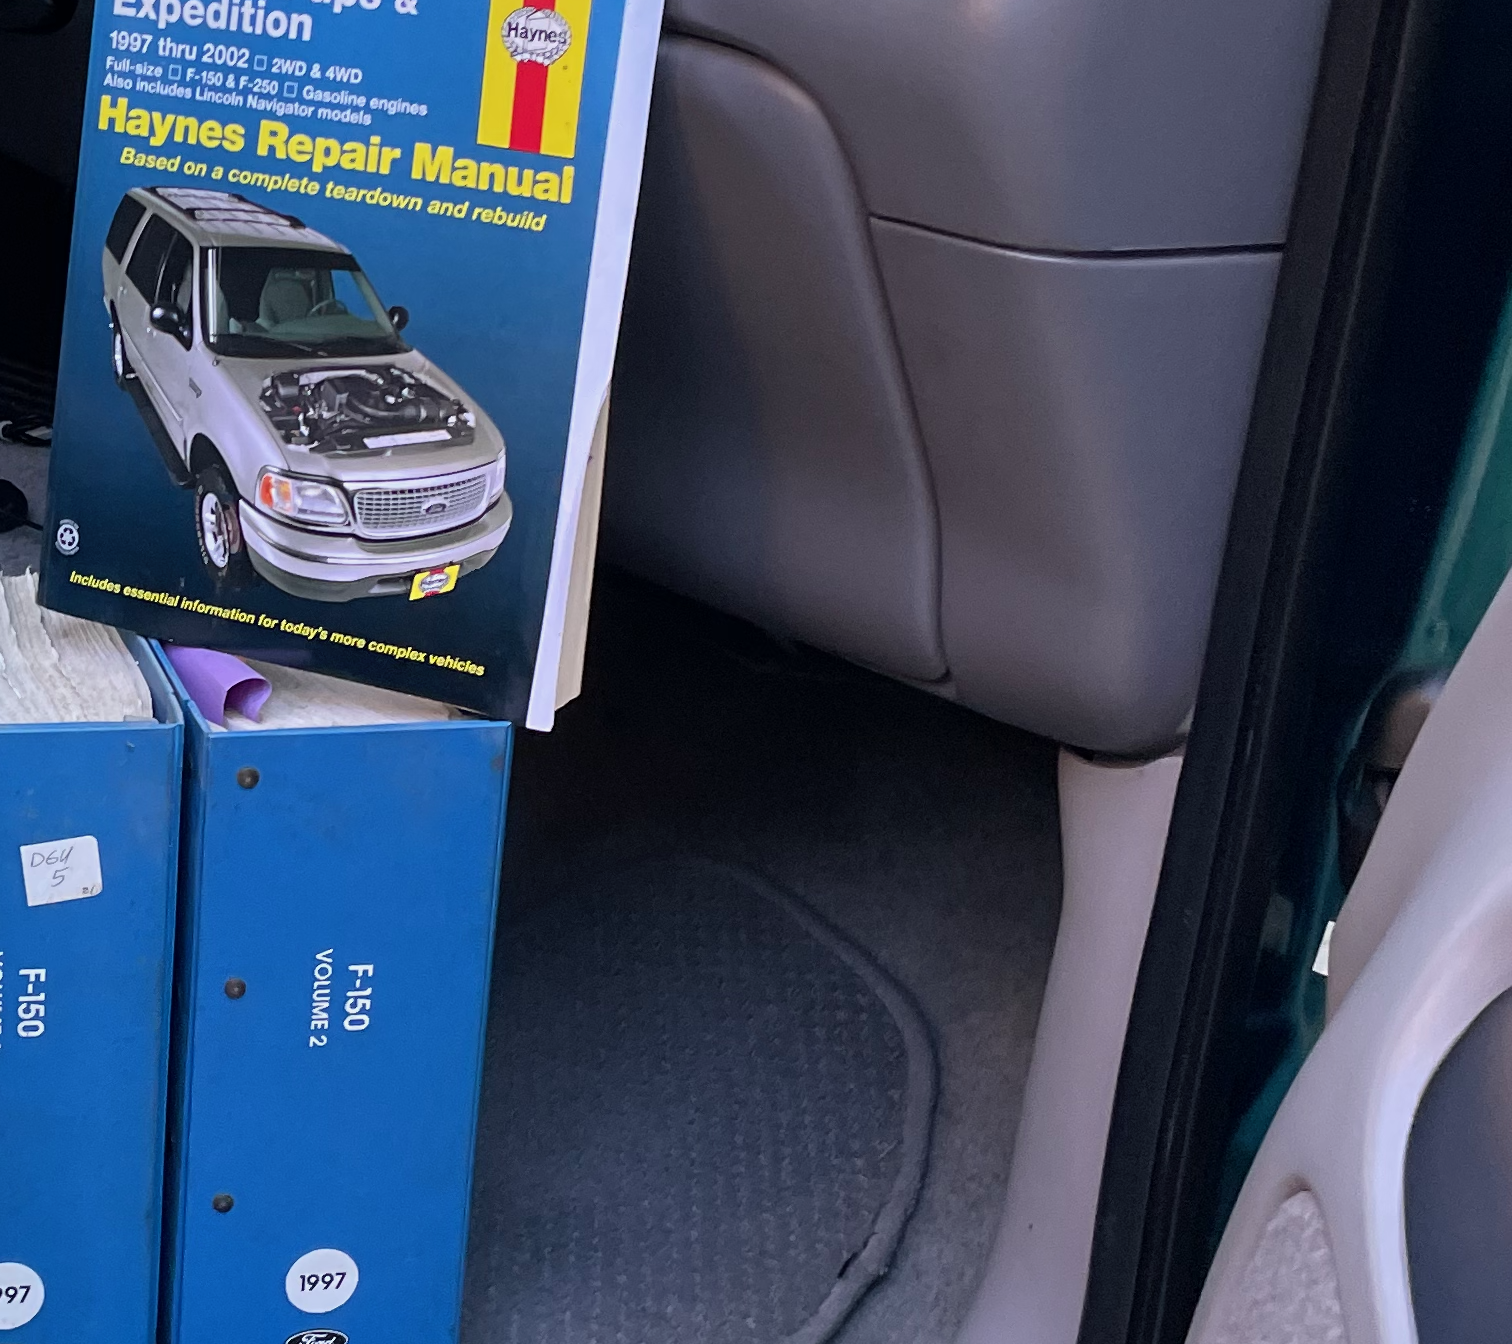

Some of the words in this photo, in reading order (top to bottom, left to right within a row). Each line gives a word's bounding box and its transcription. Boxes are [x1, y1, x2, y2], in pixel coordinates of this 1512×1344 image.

[109, 29, 153, 54] 1997
[157, 37, 197, 61] thru
[201, 42, 250, 68] 2002
[271, 58, 307, 77] 2WD
[310, 63, 321, 79] &
[325, 65, 363, 84] 4WD
[507, 21, 568, 45] Haynes
[103, 72, 133, 90] Also
[136, 77, 193, 99] includes
[195, 85, 243, 107] Lincoln
[246, 94, 315, 118] Navigator
[317, 107, 372, 126] models
[105, 56, 163, 78] Full-size
[186, 67, 223, 87] F-150
[226, 73, 235, 89] &
[239, 75, 279, 96] F-250
[302, 85, 367, 107] Gasoline
[370, 97, 428, 117] engines
[98, 94, 245, 152] Haynes
[257, 119, 402, 175] Repair
[411, 142, 575, 204] Manual
[120, 146, 181, 173] Based
[183, 161, 207, 177] on
[211, 166, 224, 181] a
[228, 169, 320, 196] complete
[325, 181, 423, 211] teardown
[427, 200, 470, 219] and
[471, 206, 548, 232] rebuild
[69, 570, 121, 594] Includes
[123, 585, 180, 608] essential
[180, 597, 255, 624] information
[257, 613, 278, 630] for
[279, 618, 328, 641] today's
[330, 631, 367, 649] more
[368, 640, 427, 663] complex
[429, 653, 486, 677] vehicles
[51, 867, 70, 888] 5
[17, 968, 46, 1038] F-150
[310, 948, 334, 1030] VOLUME
[343, 963, 374, 1031] F-150
[308, 1035, 328, 1048] 2
[299, 1272, 347, 1292] 1997
